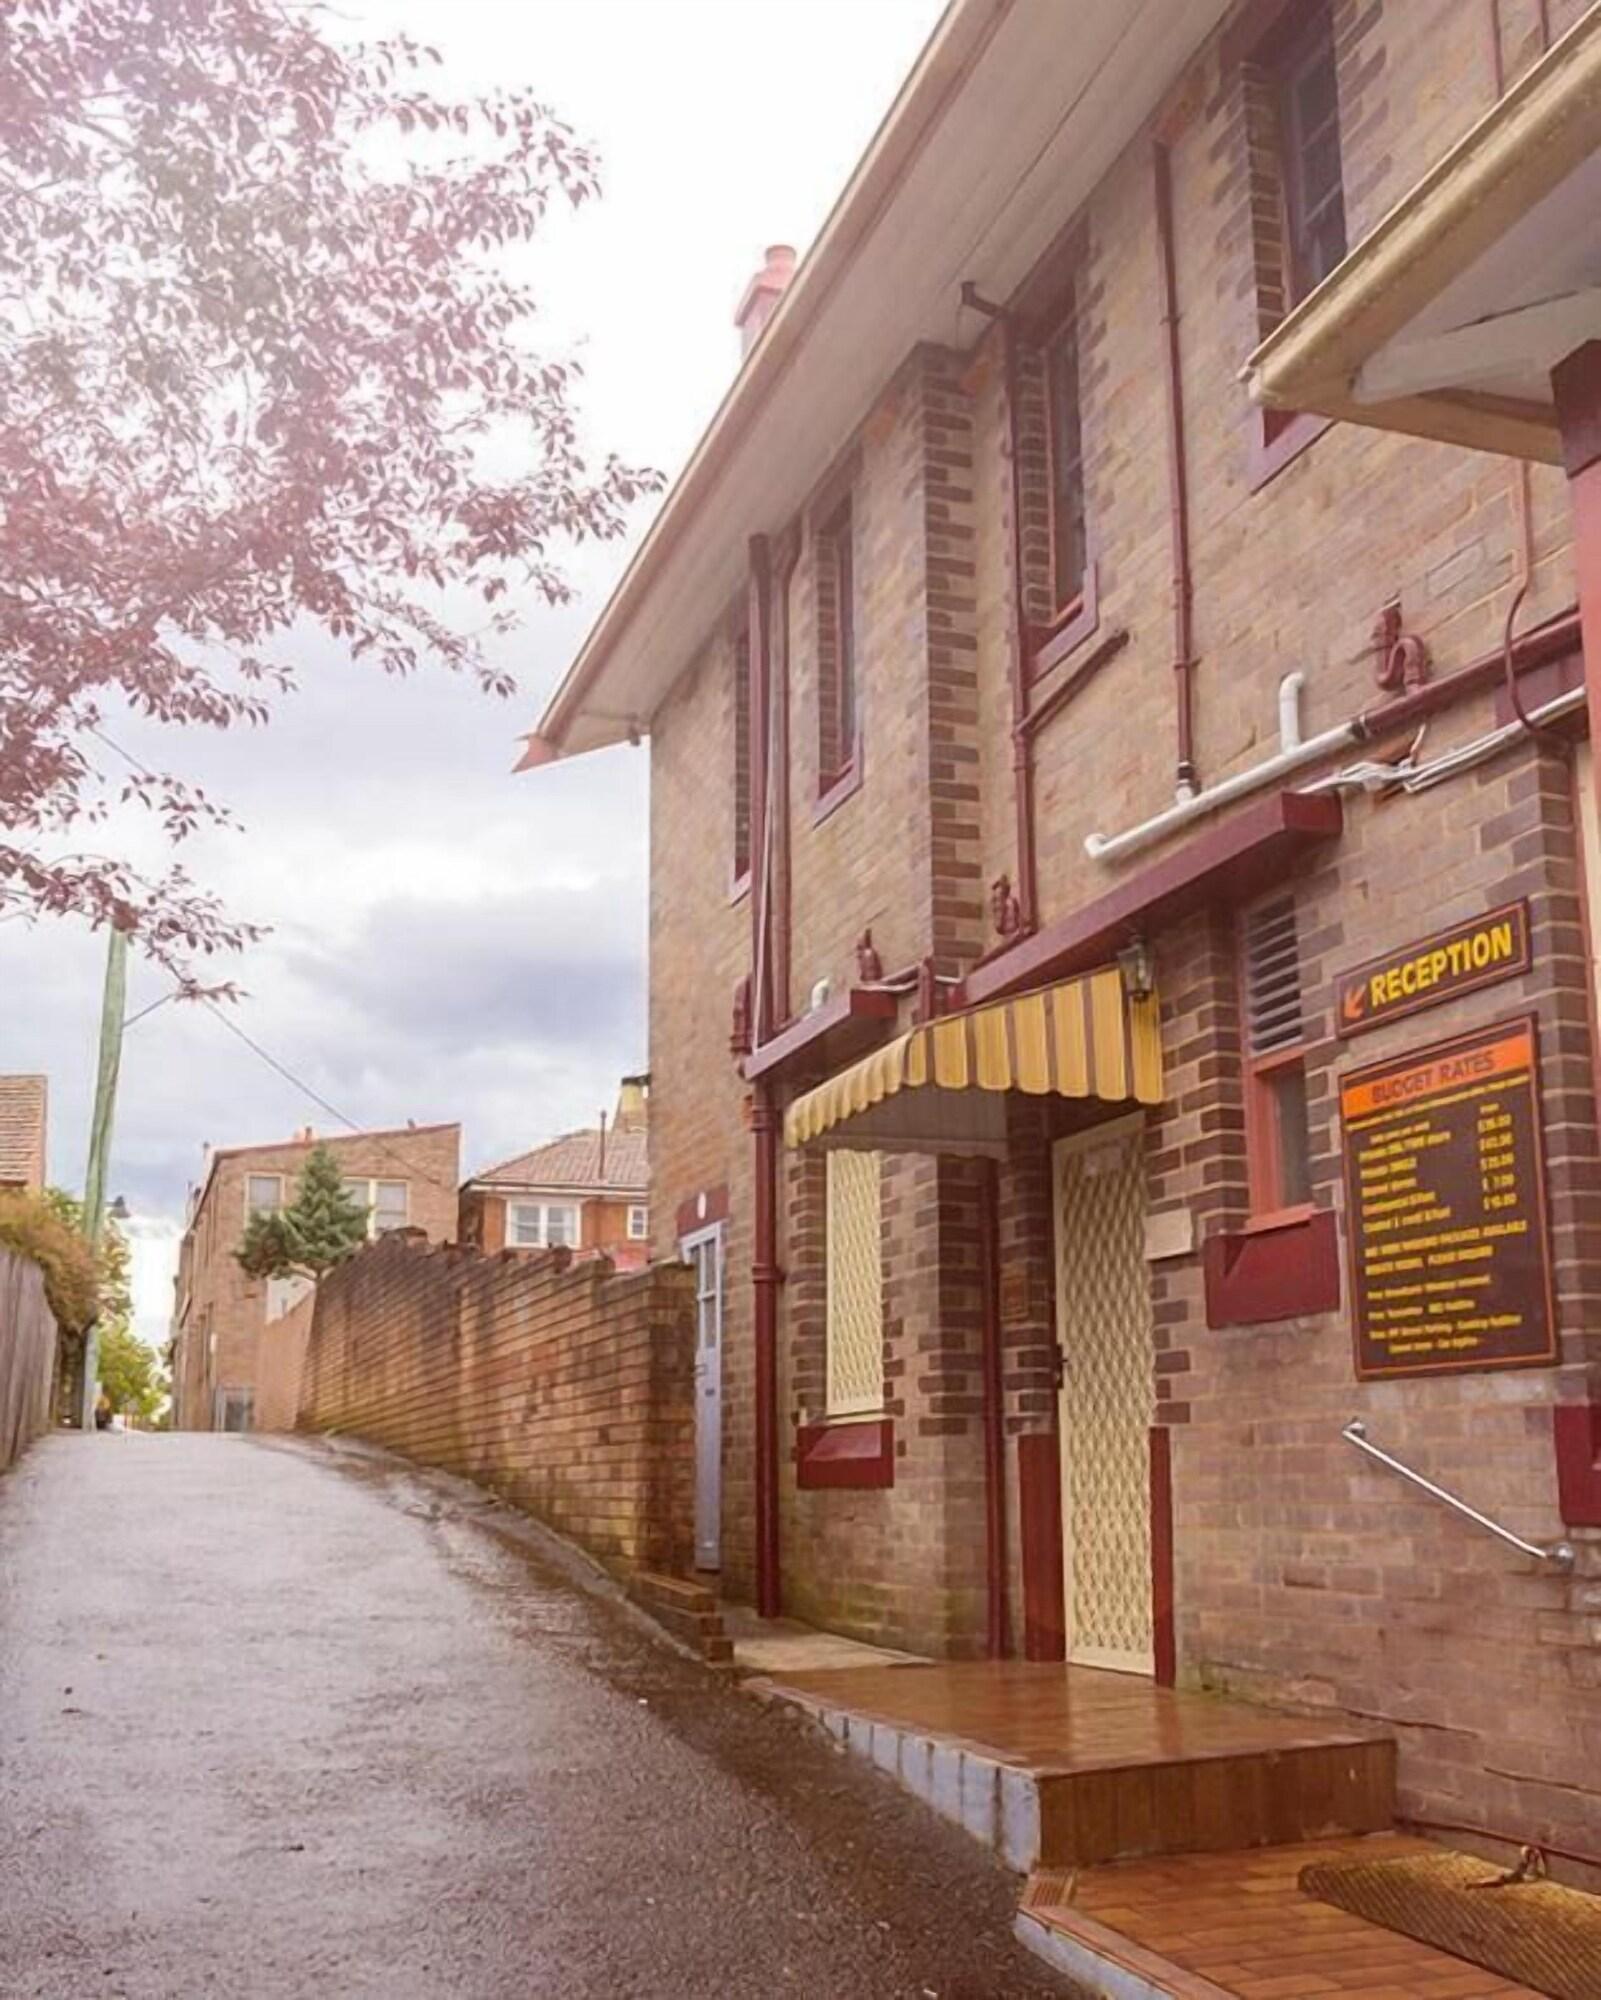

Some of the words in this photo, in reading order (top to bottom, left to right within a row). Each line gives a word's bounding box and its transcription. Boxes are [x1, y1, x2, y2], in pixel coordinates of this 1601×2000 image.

[1370, 922, 1512, 1007] RECEPTION
[1372, 1069, 1433, 1103] BUDGET
[1439, 1051, 1496, 1084] RATES
